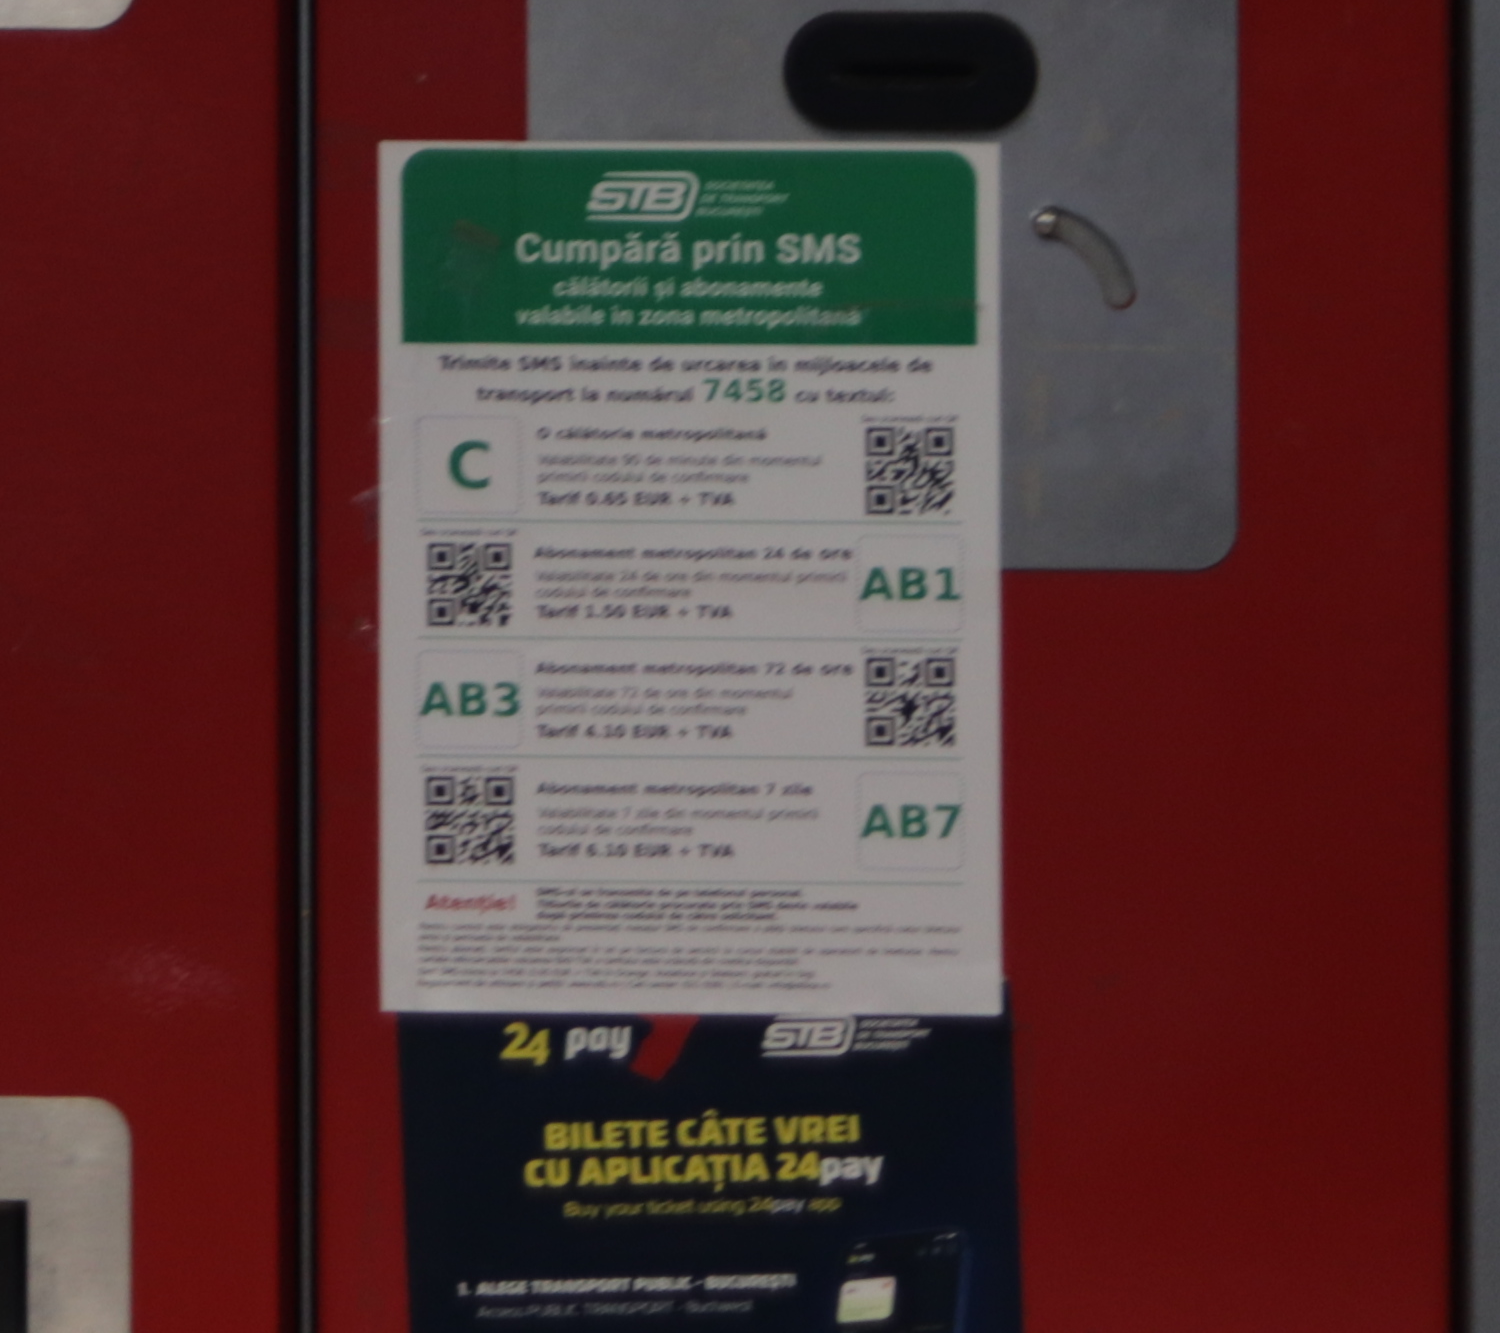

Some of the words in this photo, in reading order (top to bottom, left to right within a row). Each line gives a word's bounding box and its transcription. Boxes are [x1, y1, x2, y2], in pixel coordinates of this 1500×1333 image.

[515, 231, 682, 270] Cumpără
[692, 233, 765, 271] prin
[776, 233, 863, 264] SMS
[680, 278, 824, 299] abonamente
[638, 309, 696, 326] zona
[681, 359, 762, 373] urcarea
[476, 387, 577, 405] transport
[702, 378, 787, 404] 7458
[448, 439, 491, 490] C
[860, 566, 963, 601] AB1
[419, 681, 521, 717] AB3
[860, 803, 964, 839] AB7
[499, 1022, 551, 1066] 24
[564, 1024, 634, 1061] pay
[762, 1020, 850, 1052] STB
[543, 1116, 669, 1152] BILETE
[677, 1108, 768, 1148] CÂTE
[774, 1113, 861, 1145] VREI
[524, 1157, 570, 1188] CU
[578, 1153, 771, 1194] APLICAȚIA
[776, 1151, 885, 1186] 24pay
